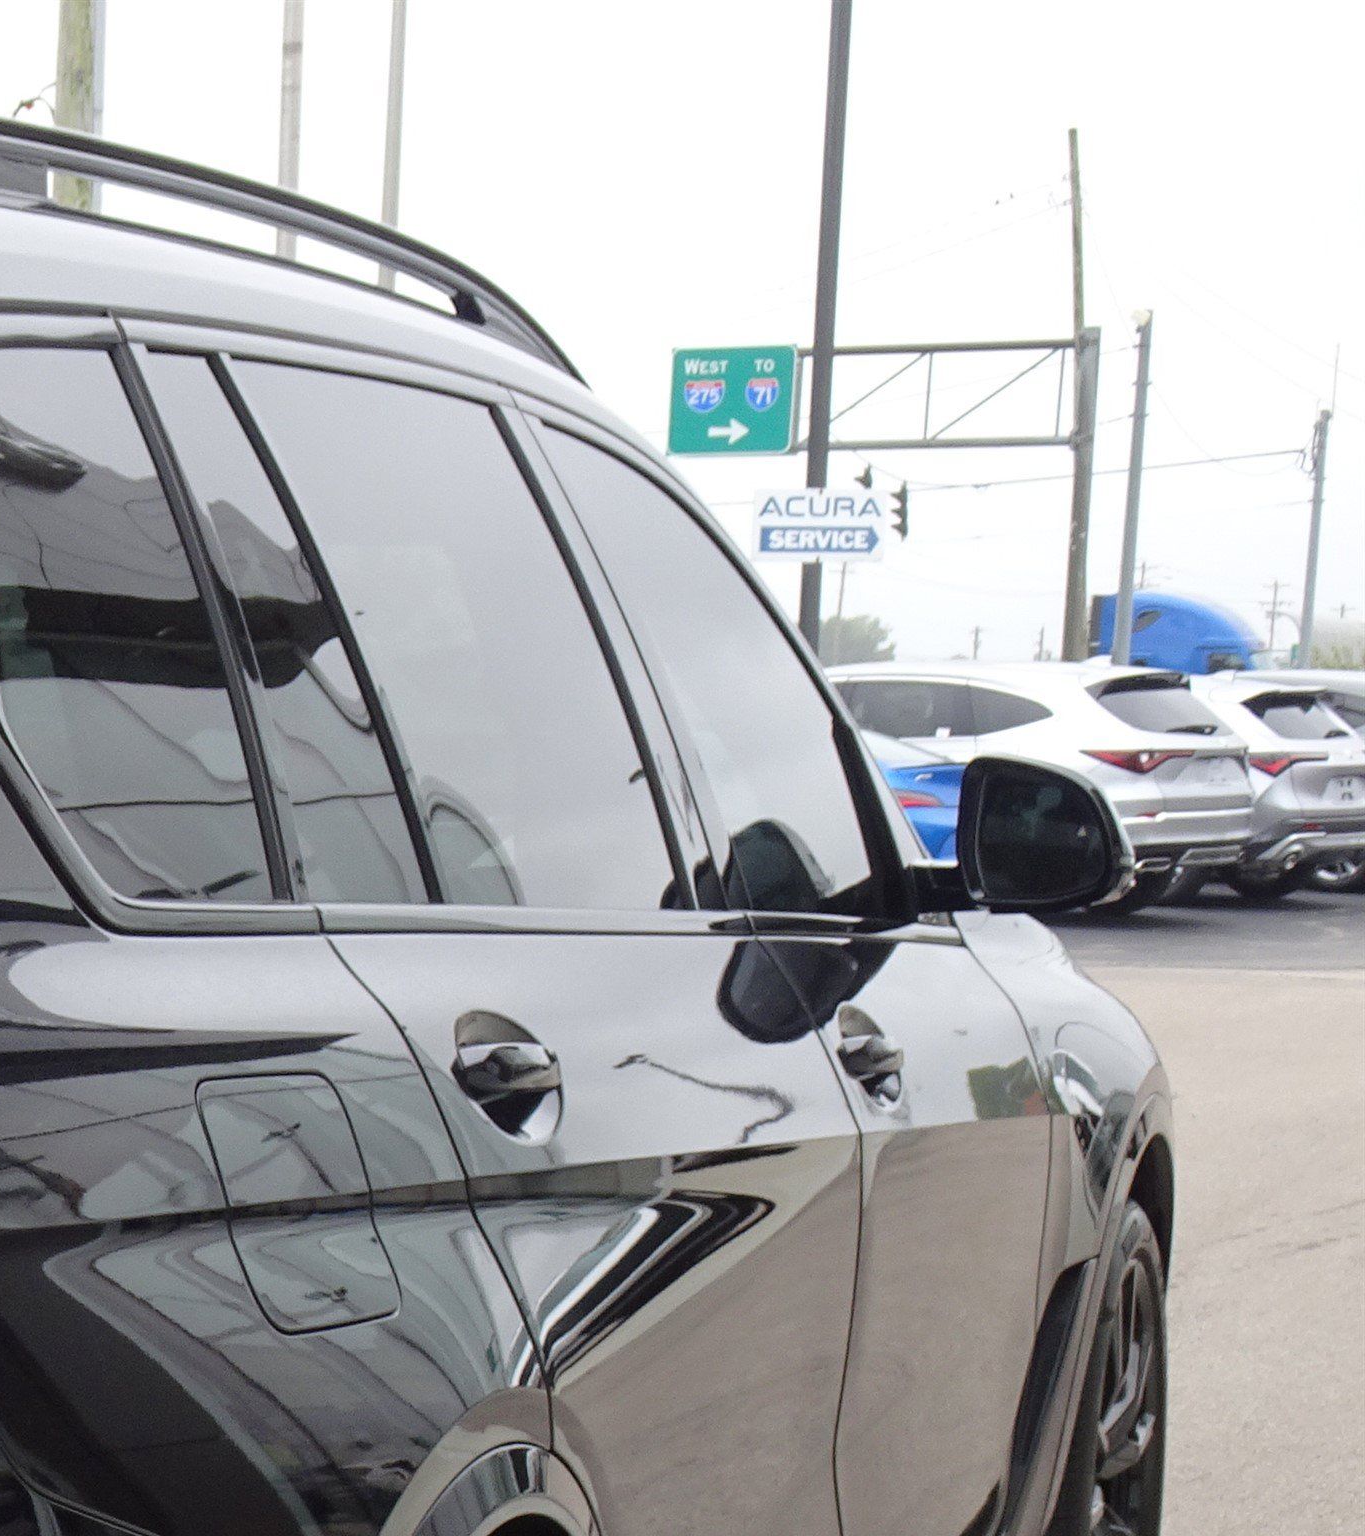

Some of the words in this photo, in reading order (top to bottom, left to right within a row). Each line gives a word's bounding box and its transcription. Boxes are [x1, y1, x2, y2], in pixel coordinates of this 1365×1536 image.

[684, 358, 728, 375] WEST
[754, 358, 775, 374] TO
[688, 388, 722, 405] 275
[753, 386, 773, 405] 71
[759, 496, 881, 517] ACURA
[768, 529, 870, 549] SERVICE
